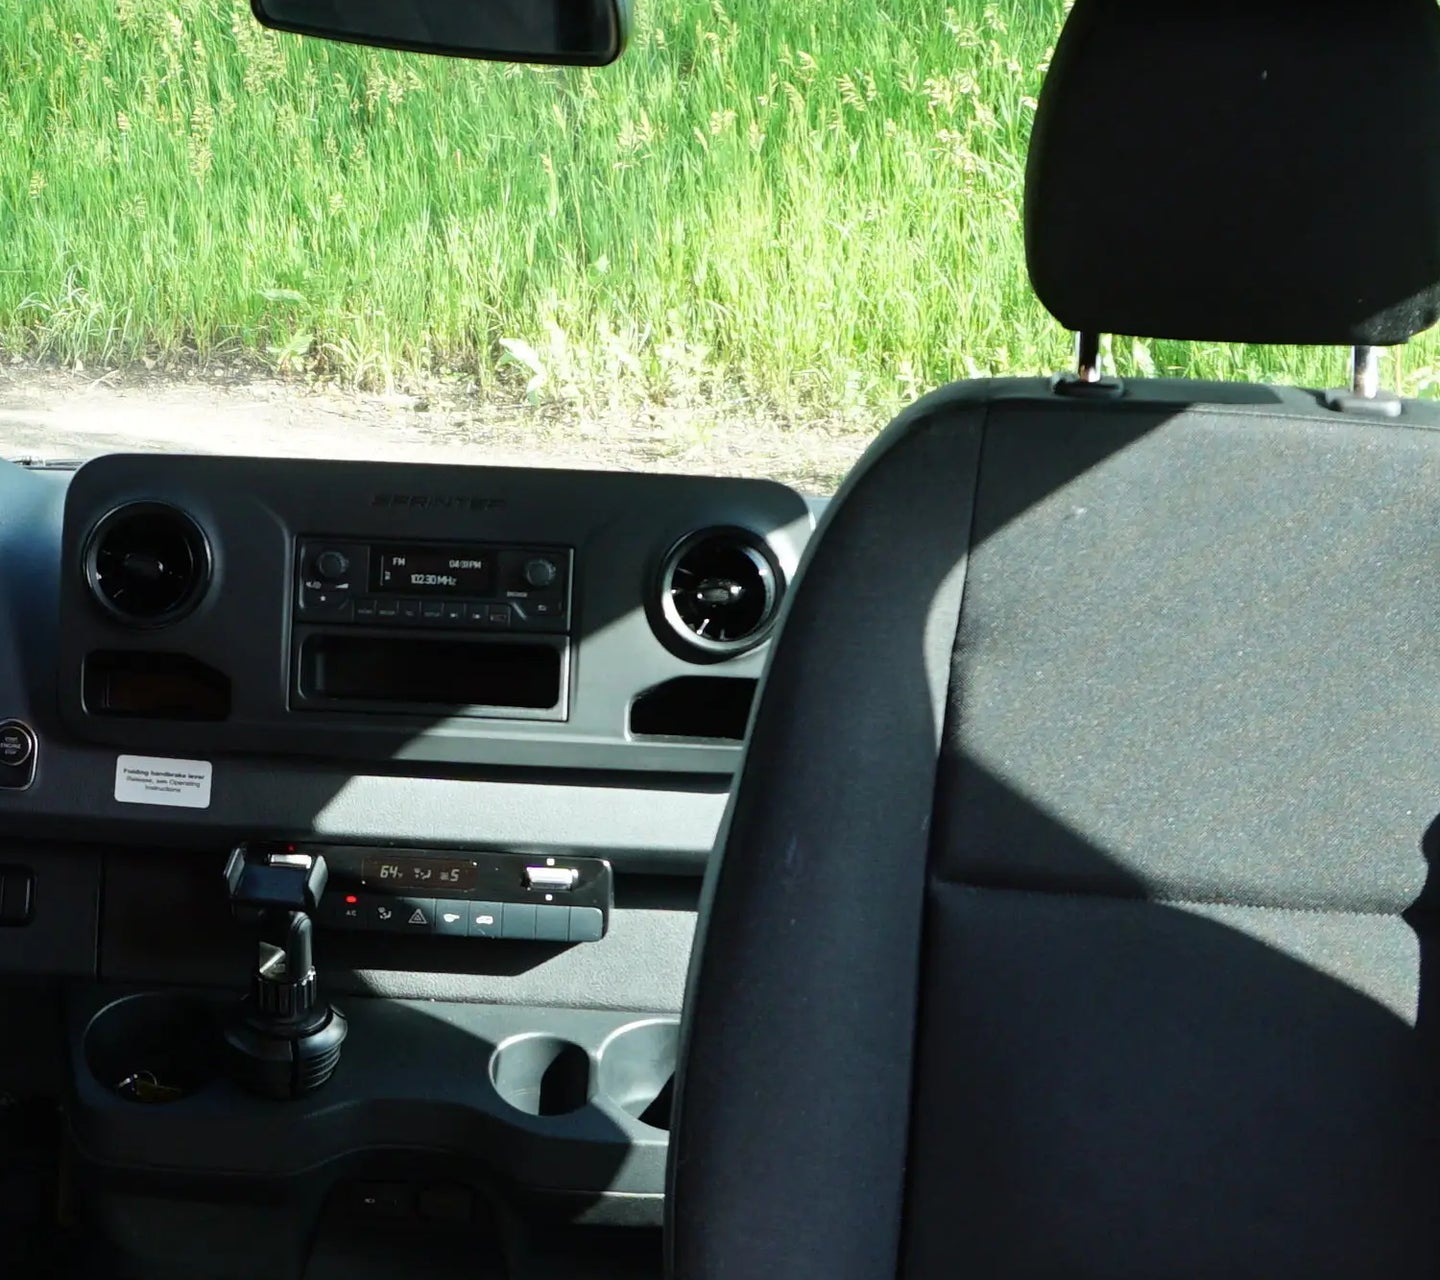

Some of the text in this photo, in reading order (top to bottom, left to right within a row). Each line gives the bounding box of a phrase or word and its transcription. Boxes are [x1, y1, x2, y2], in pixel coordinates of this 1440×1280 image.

[392, 557, 406, 566] FM
[150, 770, 186, 779] handbrake
[169, 780, 201, 789] Operating
